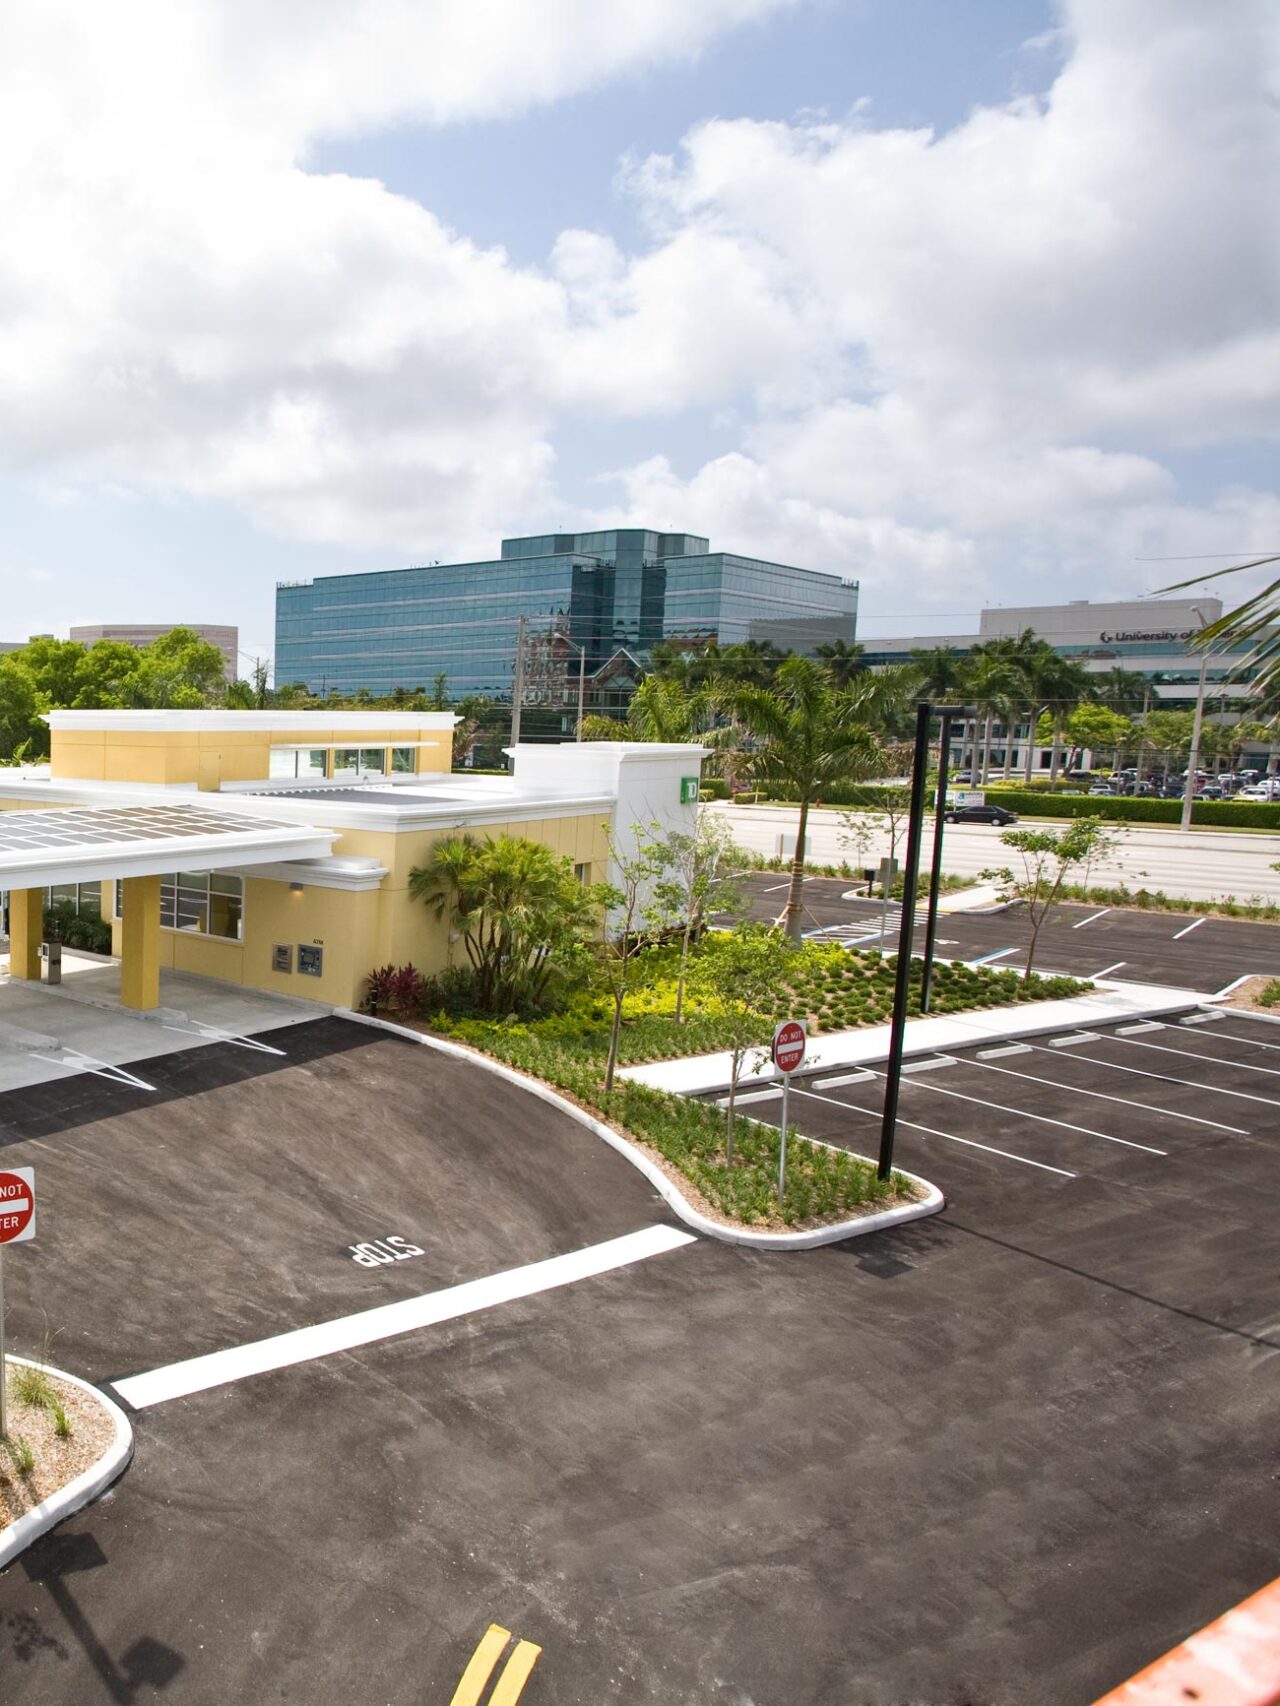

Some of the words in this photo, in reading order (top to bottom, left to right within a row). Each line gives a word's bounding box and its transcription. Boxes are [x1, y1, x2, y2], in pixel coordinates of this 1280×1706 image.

[1116, 631, 1177, 641] University
[780, 1033, 788, 1043] DO
[790, 1030, 802, 1040] NOT
[781, 1053, 799, 1064] ENTER
[0, 1183, 23, 1198] NOT
[347, 1235, 426, 1268] STOP
